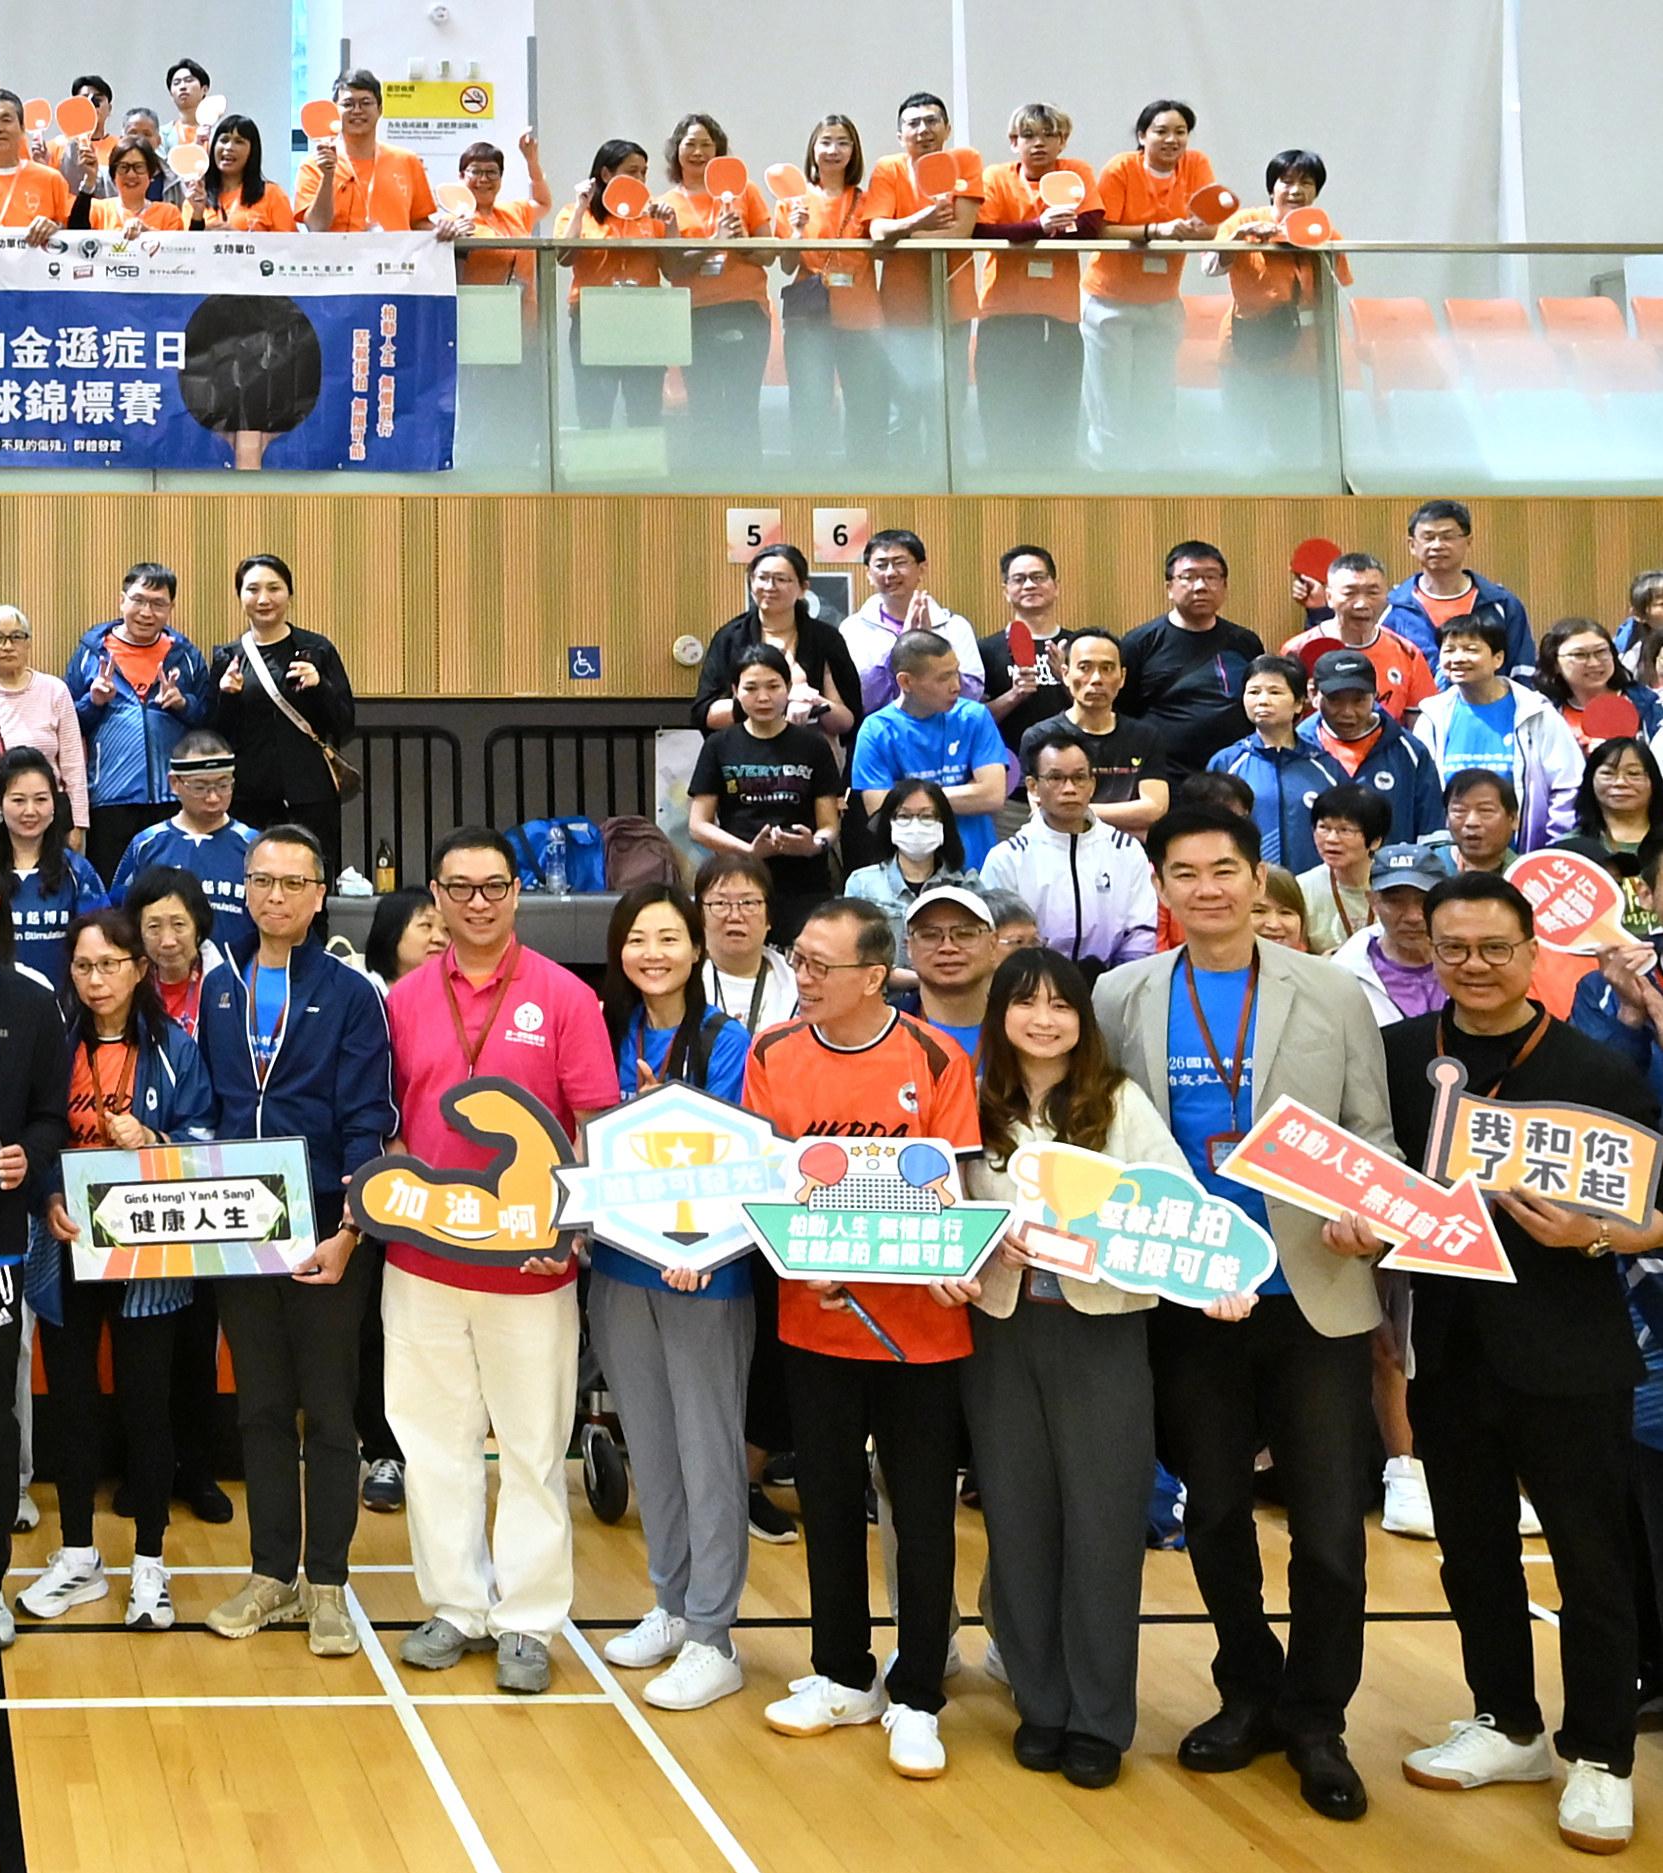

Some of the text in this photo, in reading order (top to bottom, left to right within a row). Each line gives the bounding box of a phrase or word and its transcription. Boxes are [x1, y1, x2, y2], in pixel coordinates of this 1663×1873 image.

[212, 243, 256, 255] 支持單位
[105, 265, 140, 278] MSB
[747, 525, 762, 546] 5
[833, 524, 848, 546] 6
[1469, 1110, 1633, 1168] 我和你
[1275, 1117, 1485, 1258] 柏動人生 無懼前行
[1470, 1147, 1629, 1209] 了不起
[129, 1206, 249, 1234] 健康人生
[384, 1177, 536, 1240] 加油啊
[1103, 1233, 1241, 1293] 無限可能
